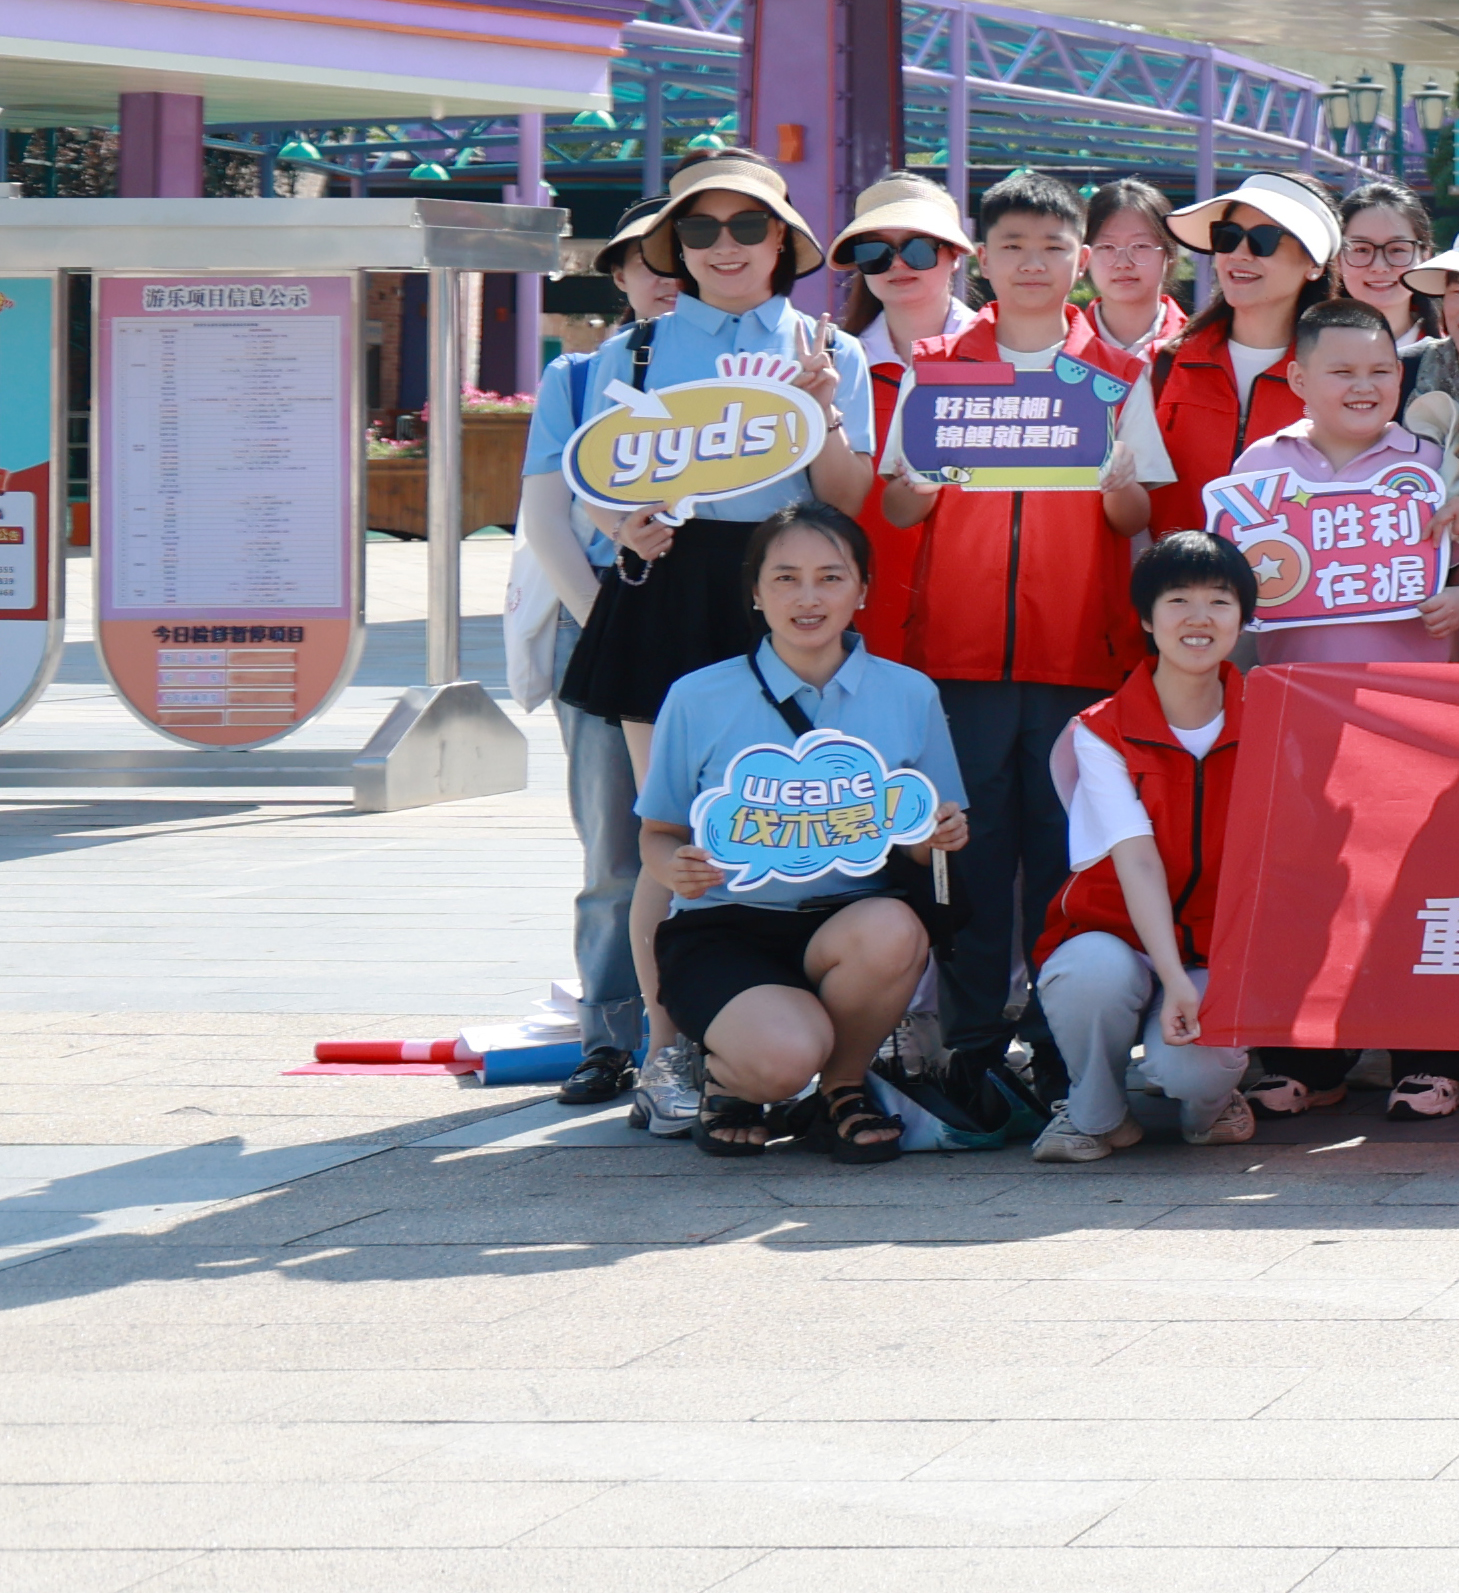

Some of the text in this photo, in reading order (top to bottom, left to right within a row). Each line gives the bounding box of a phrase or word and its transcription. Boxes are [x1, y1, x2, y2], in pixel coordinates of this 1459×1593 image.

[145, 287, 309, 309] 游乐项目信息公示
[609, 401, 802, 486] yyds!
[934, 425, 1078, 449] 锦鲤就是你
[1312, 500, 1423, 550] 胜利
[1316, 556, 1425, 609] 在握
